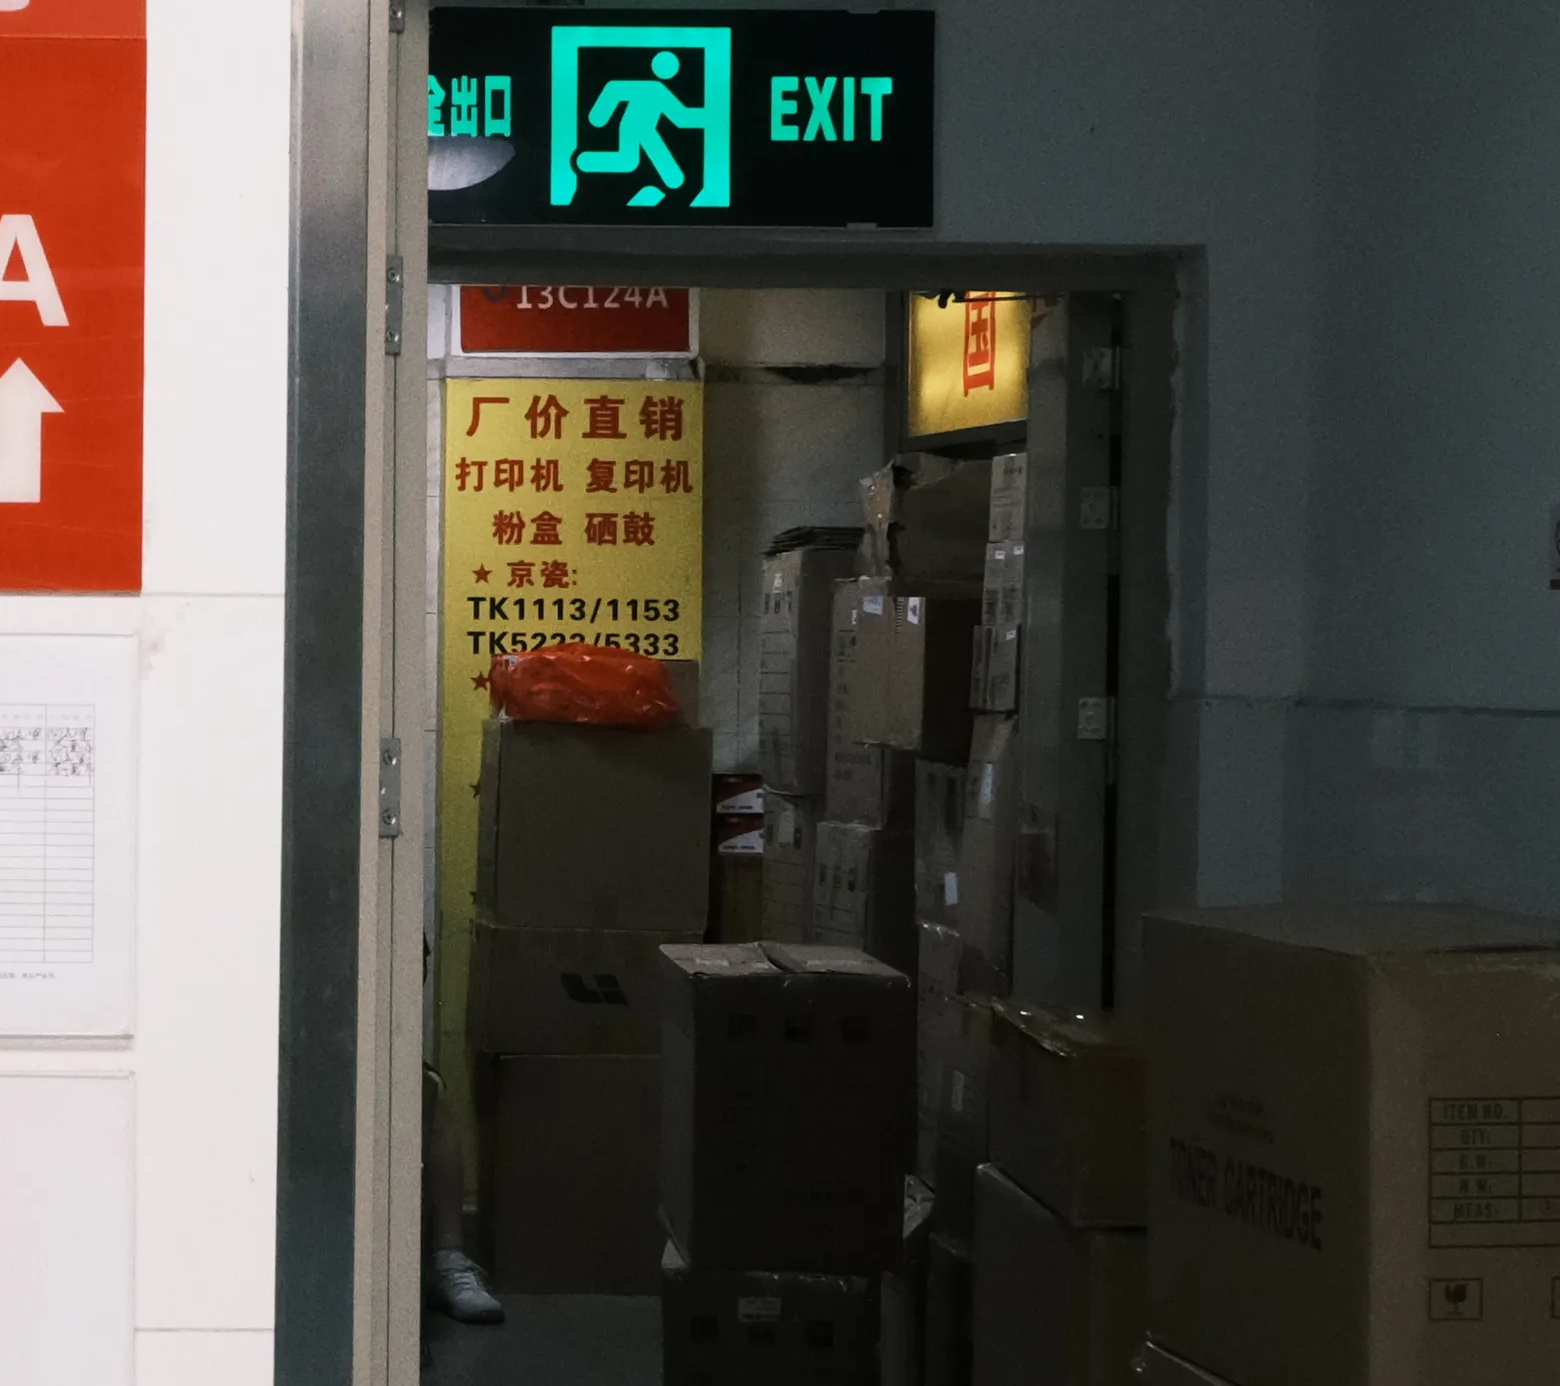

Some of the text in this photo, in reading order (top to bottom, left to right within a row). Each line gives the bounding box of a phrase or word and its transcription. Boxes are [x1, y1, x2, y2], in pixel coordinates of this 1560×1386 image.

[770, 76, 893, 142] EXIT
[465, 395, 685, 441] 厂价直销
[455, 456, 693, 494] 打印机 复印机
[492, 511, 656, 547] 粉盒 硒鼓
[467, 596, 680, 624] TK1113/1153
